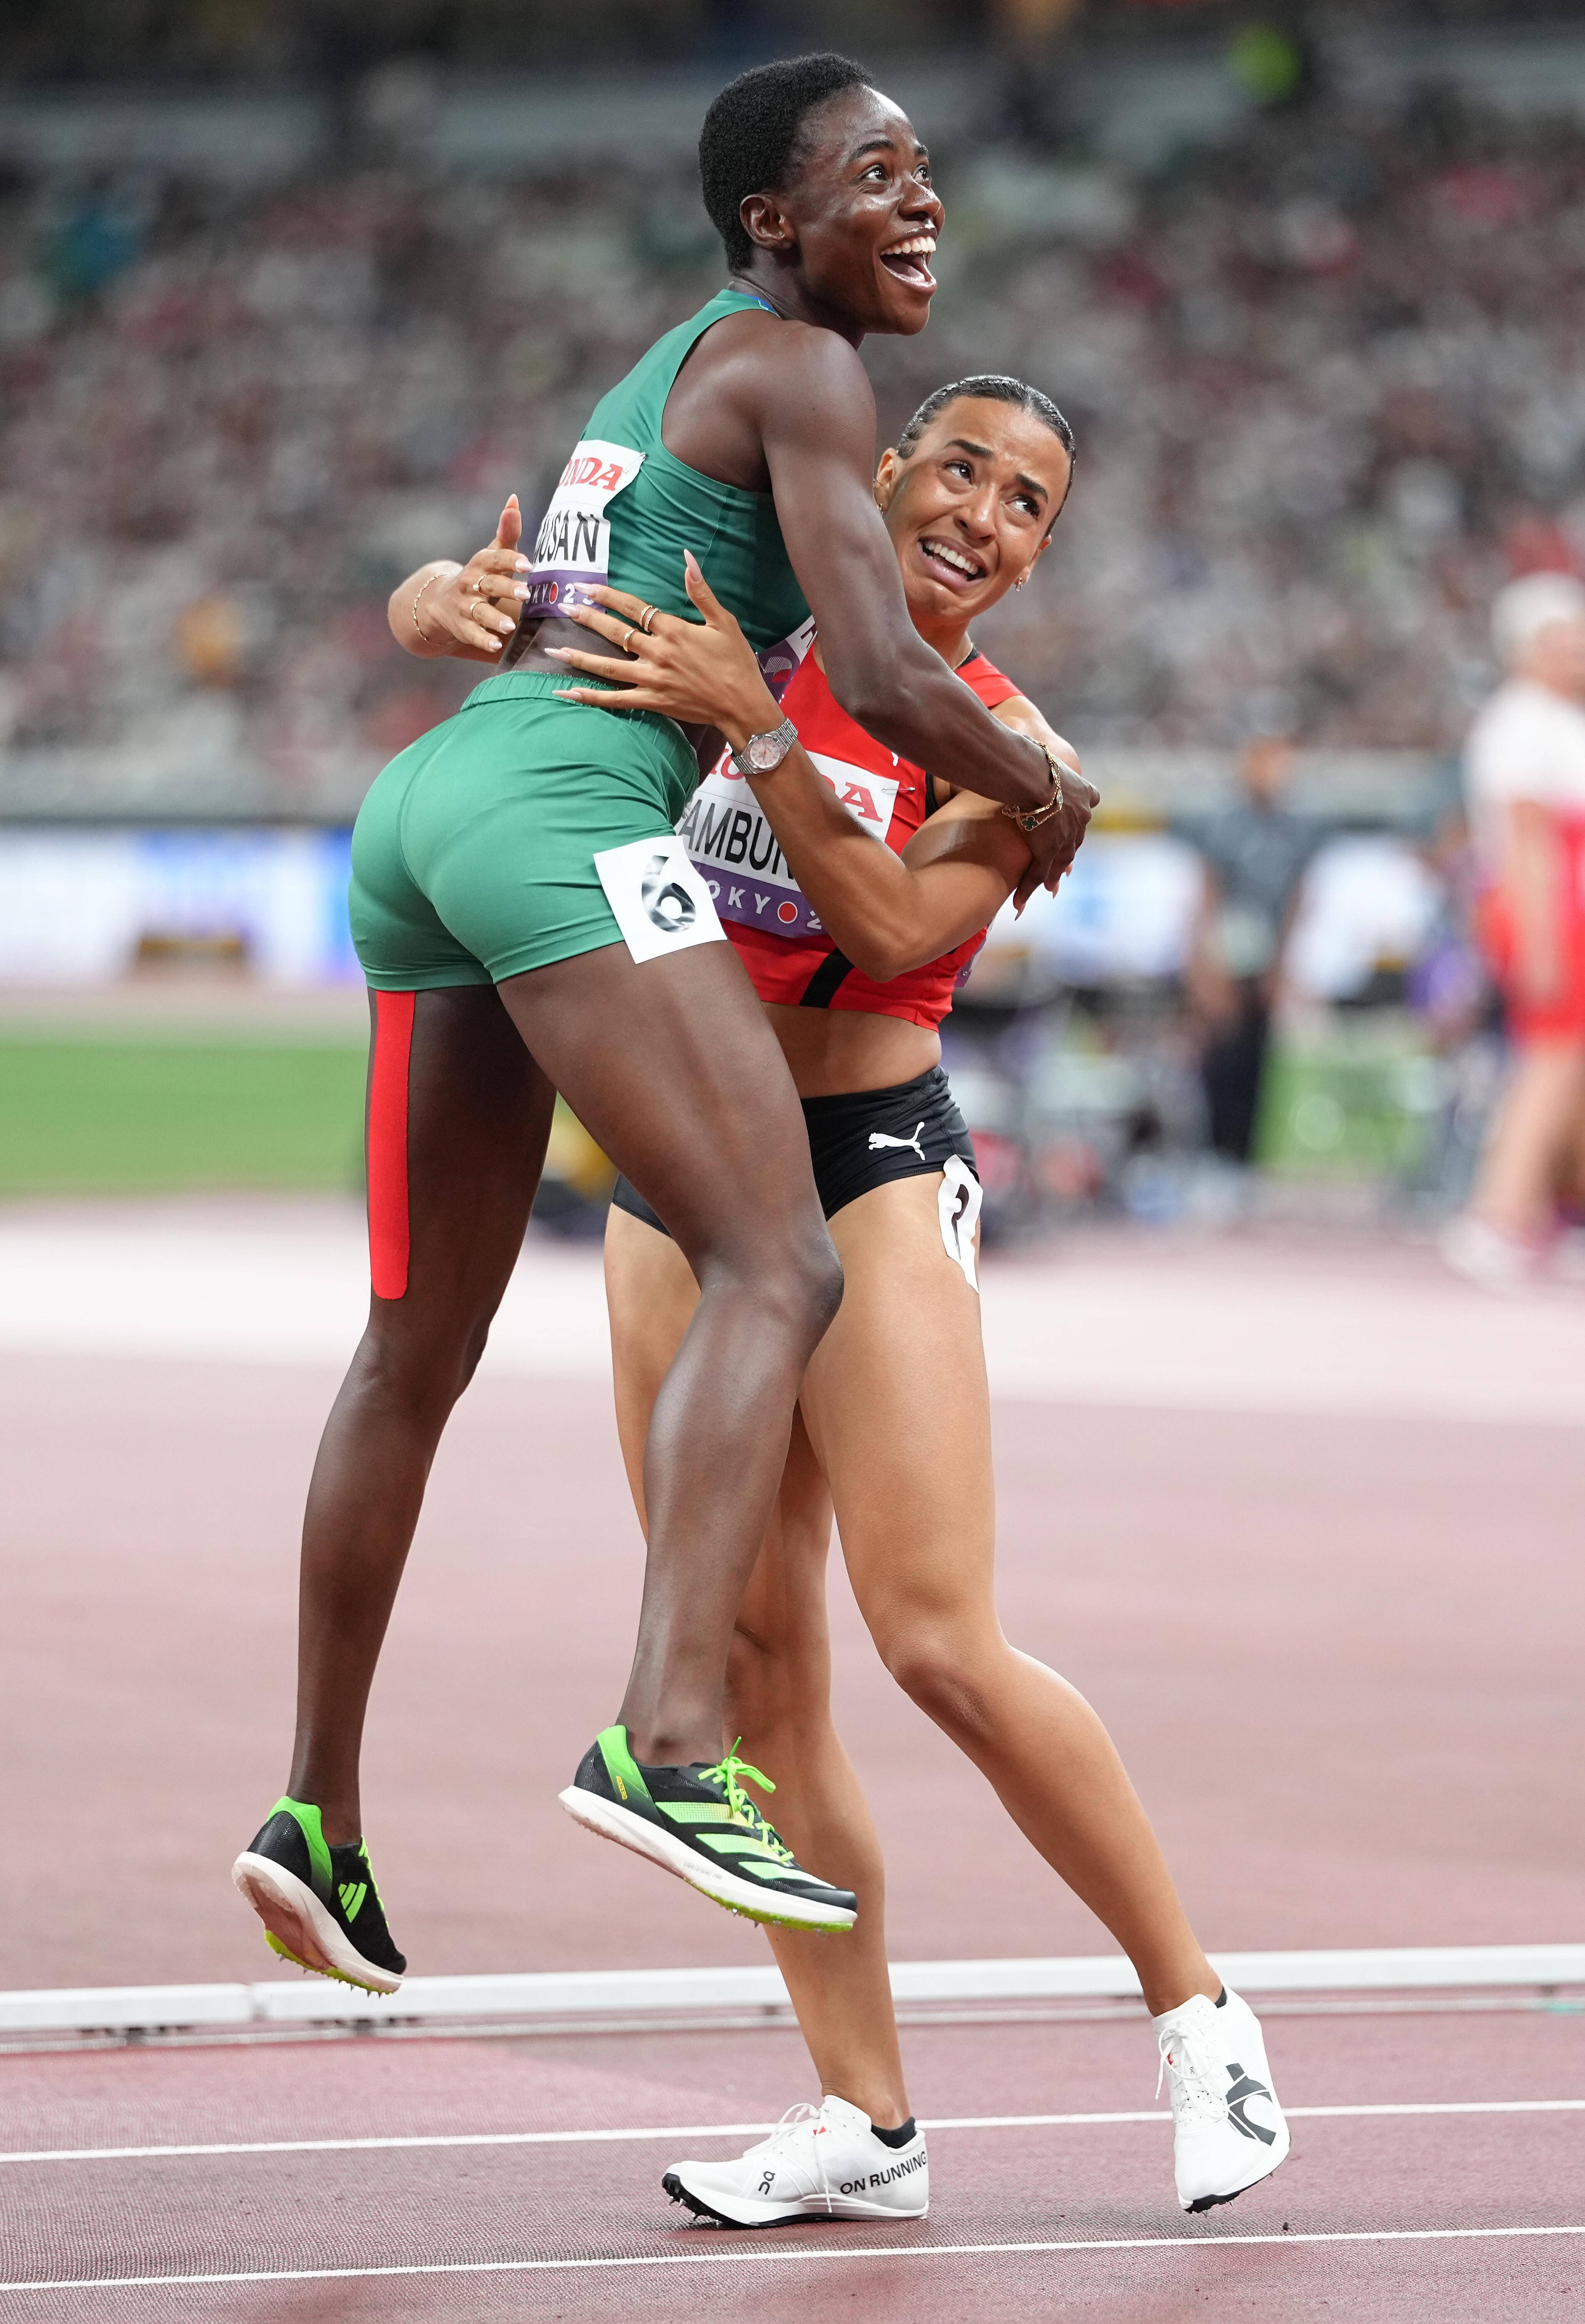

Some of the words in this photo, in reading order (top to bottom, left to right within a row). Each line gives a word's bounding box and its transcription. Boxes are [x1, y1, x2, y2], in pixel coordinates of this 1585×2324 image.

[641, 855, 697, 933] 6
[840, 2178, 866, 2195] ON
[870, 2151, 927, 2188] RUNNING
